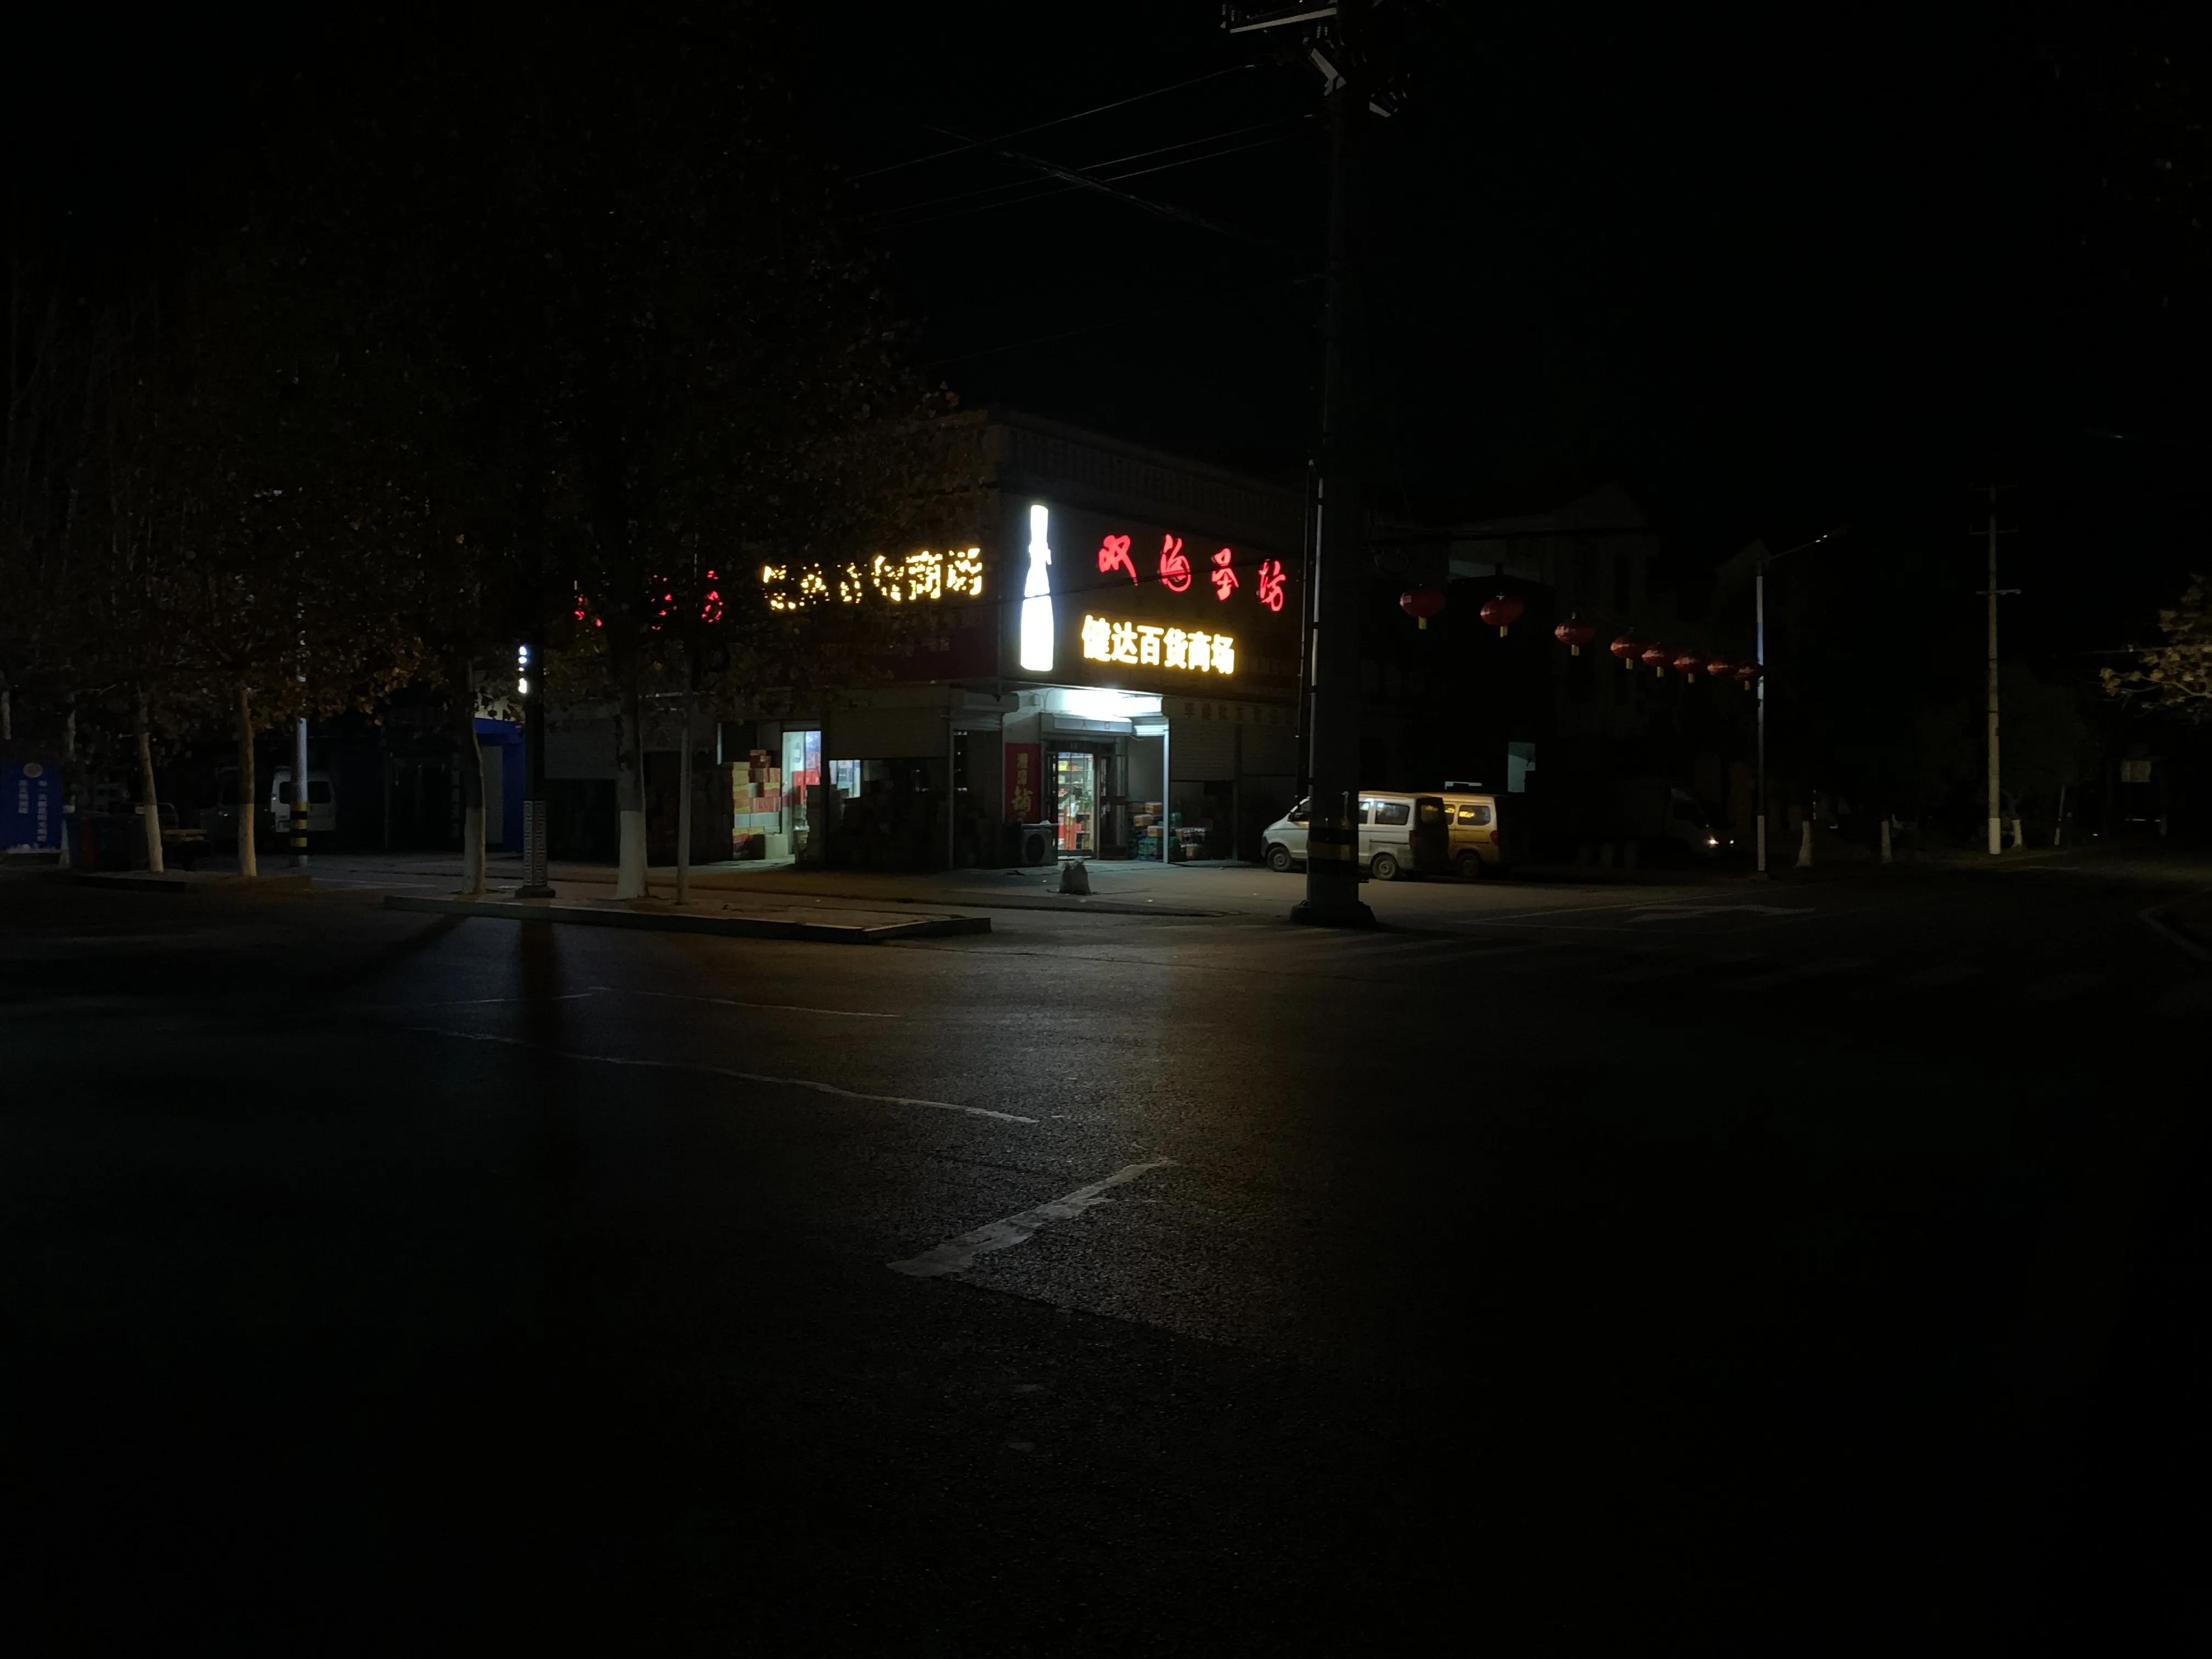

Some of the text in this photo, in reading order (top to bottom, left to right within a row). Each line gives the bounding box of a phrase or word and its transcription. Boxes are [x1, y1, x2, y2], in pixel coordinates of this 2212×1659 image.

[1081, 614, 1235, 674] 健达百货商场
